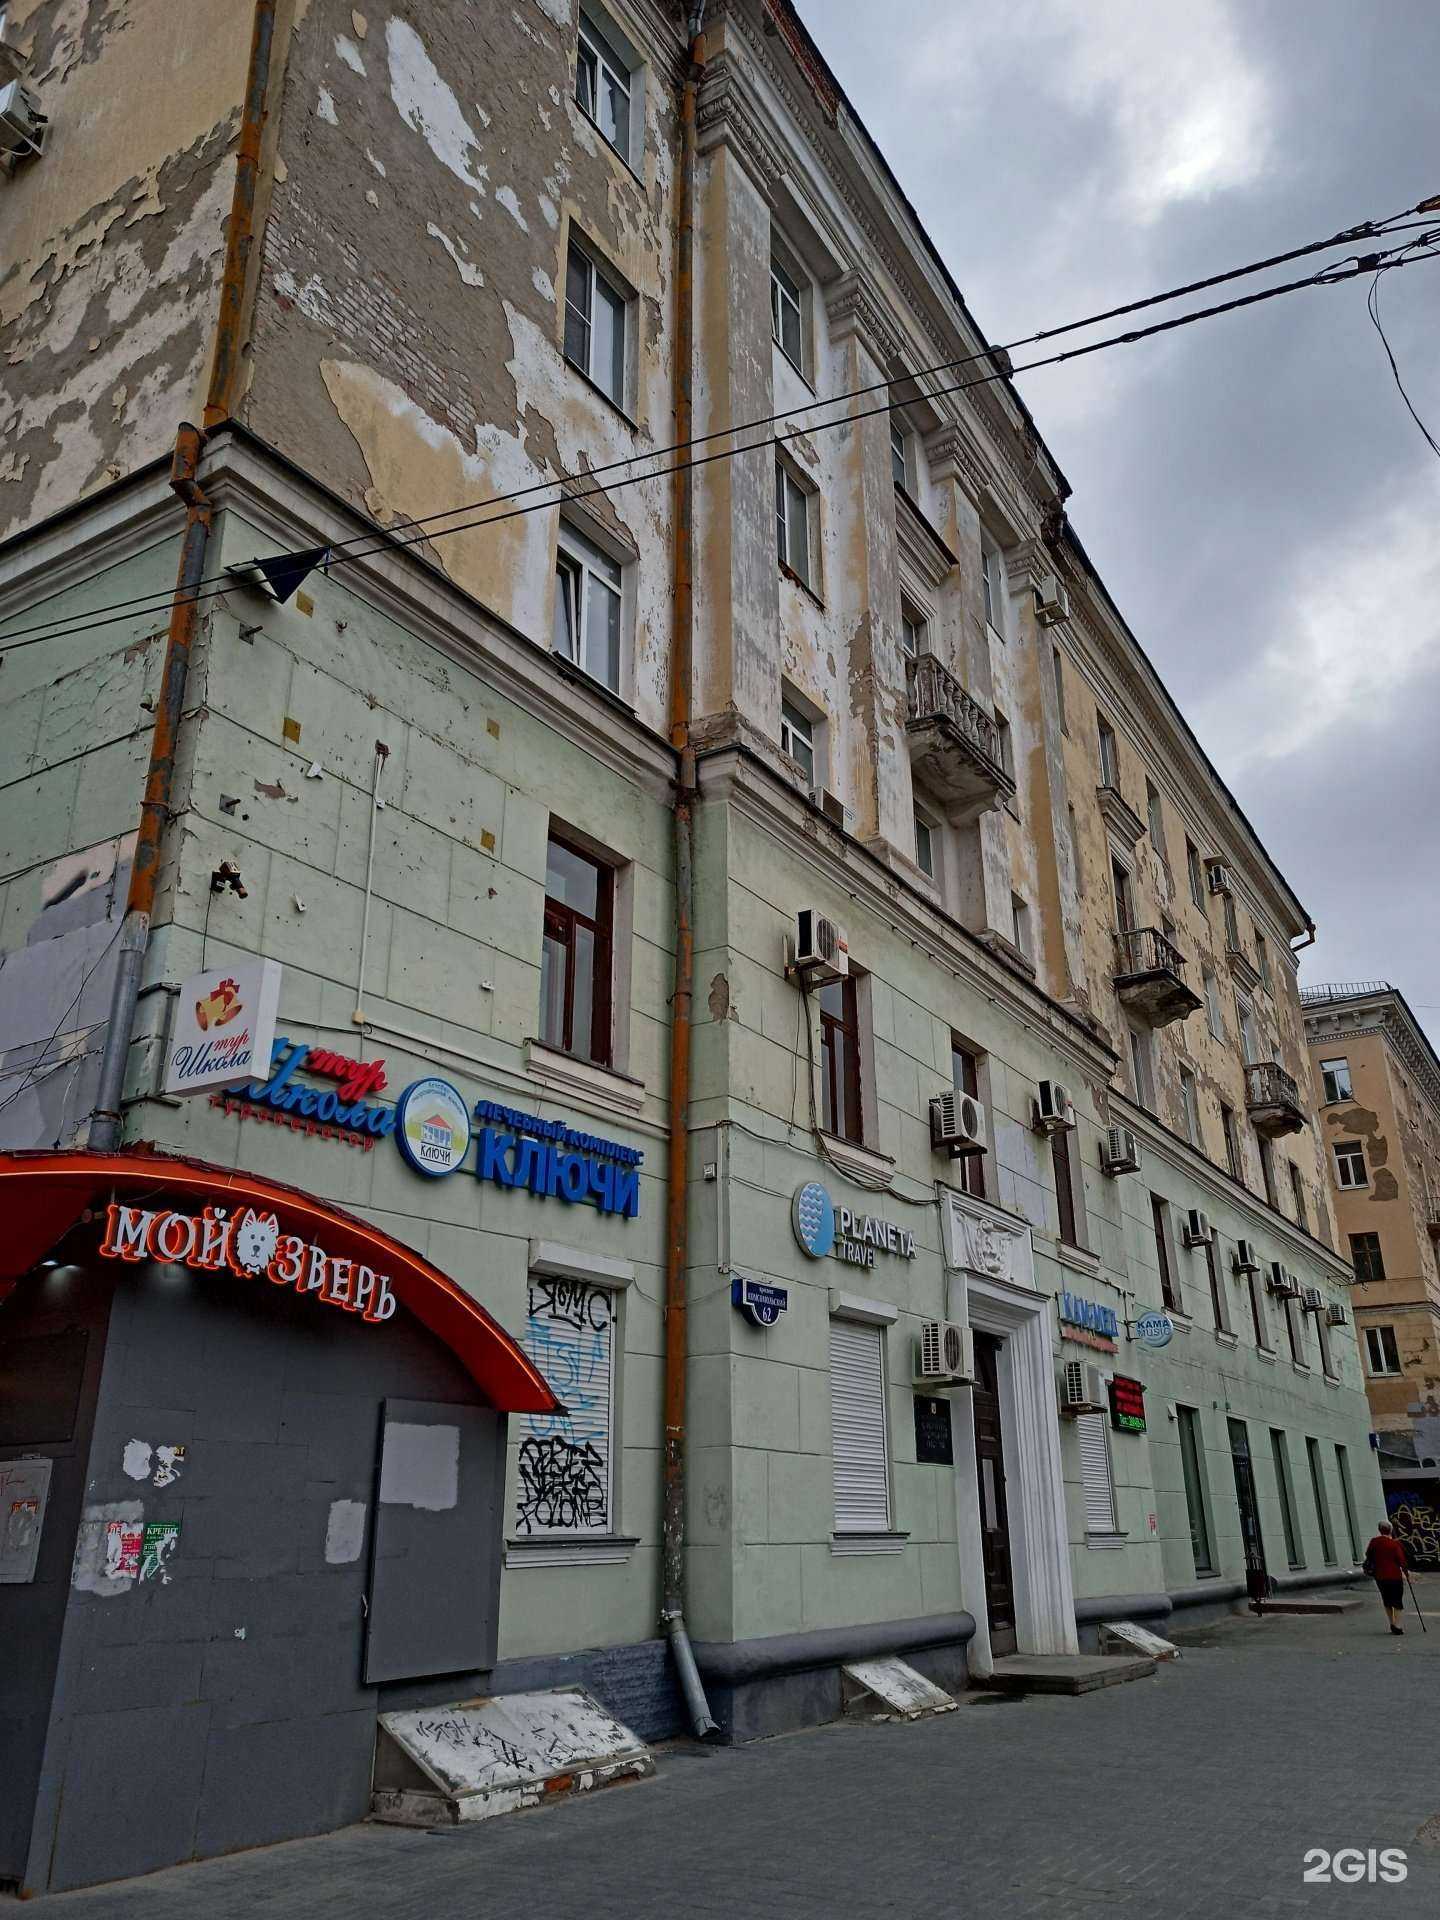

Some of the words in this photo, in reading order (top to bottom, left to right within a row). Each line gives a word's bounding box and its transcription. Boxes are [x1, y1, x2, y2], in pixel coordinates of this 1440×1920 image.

[173, 1040, 251, 1079] Школа
[213, 1028, 250, 1057] тур
[475, 1100, 567, 1142] ЛЕЧЕБНЫЙ
[420, 1144, 451, 1162] КЛЮЧИ
[478, 1128, 639, 1218] КЛЮЧИ
[841, 1206, 919, 1259] PLANETA
[105, 1205, 231, 1269] МОЙ
[271, 1235, 397, 1321] ЗВЕРЬ
[762, 1306, 772, 1322] 62
[1137, 1320, 1170, 1329] KAMA
[1137, 1328, 1171, 1337] MUSIC
